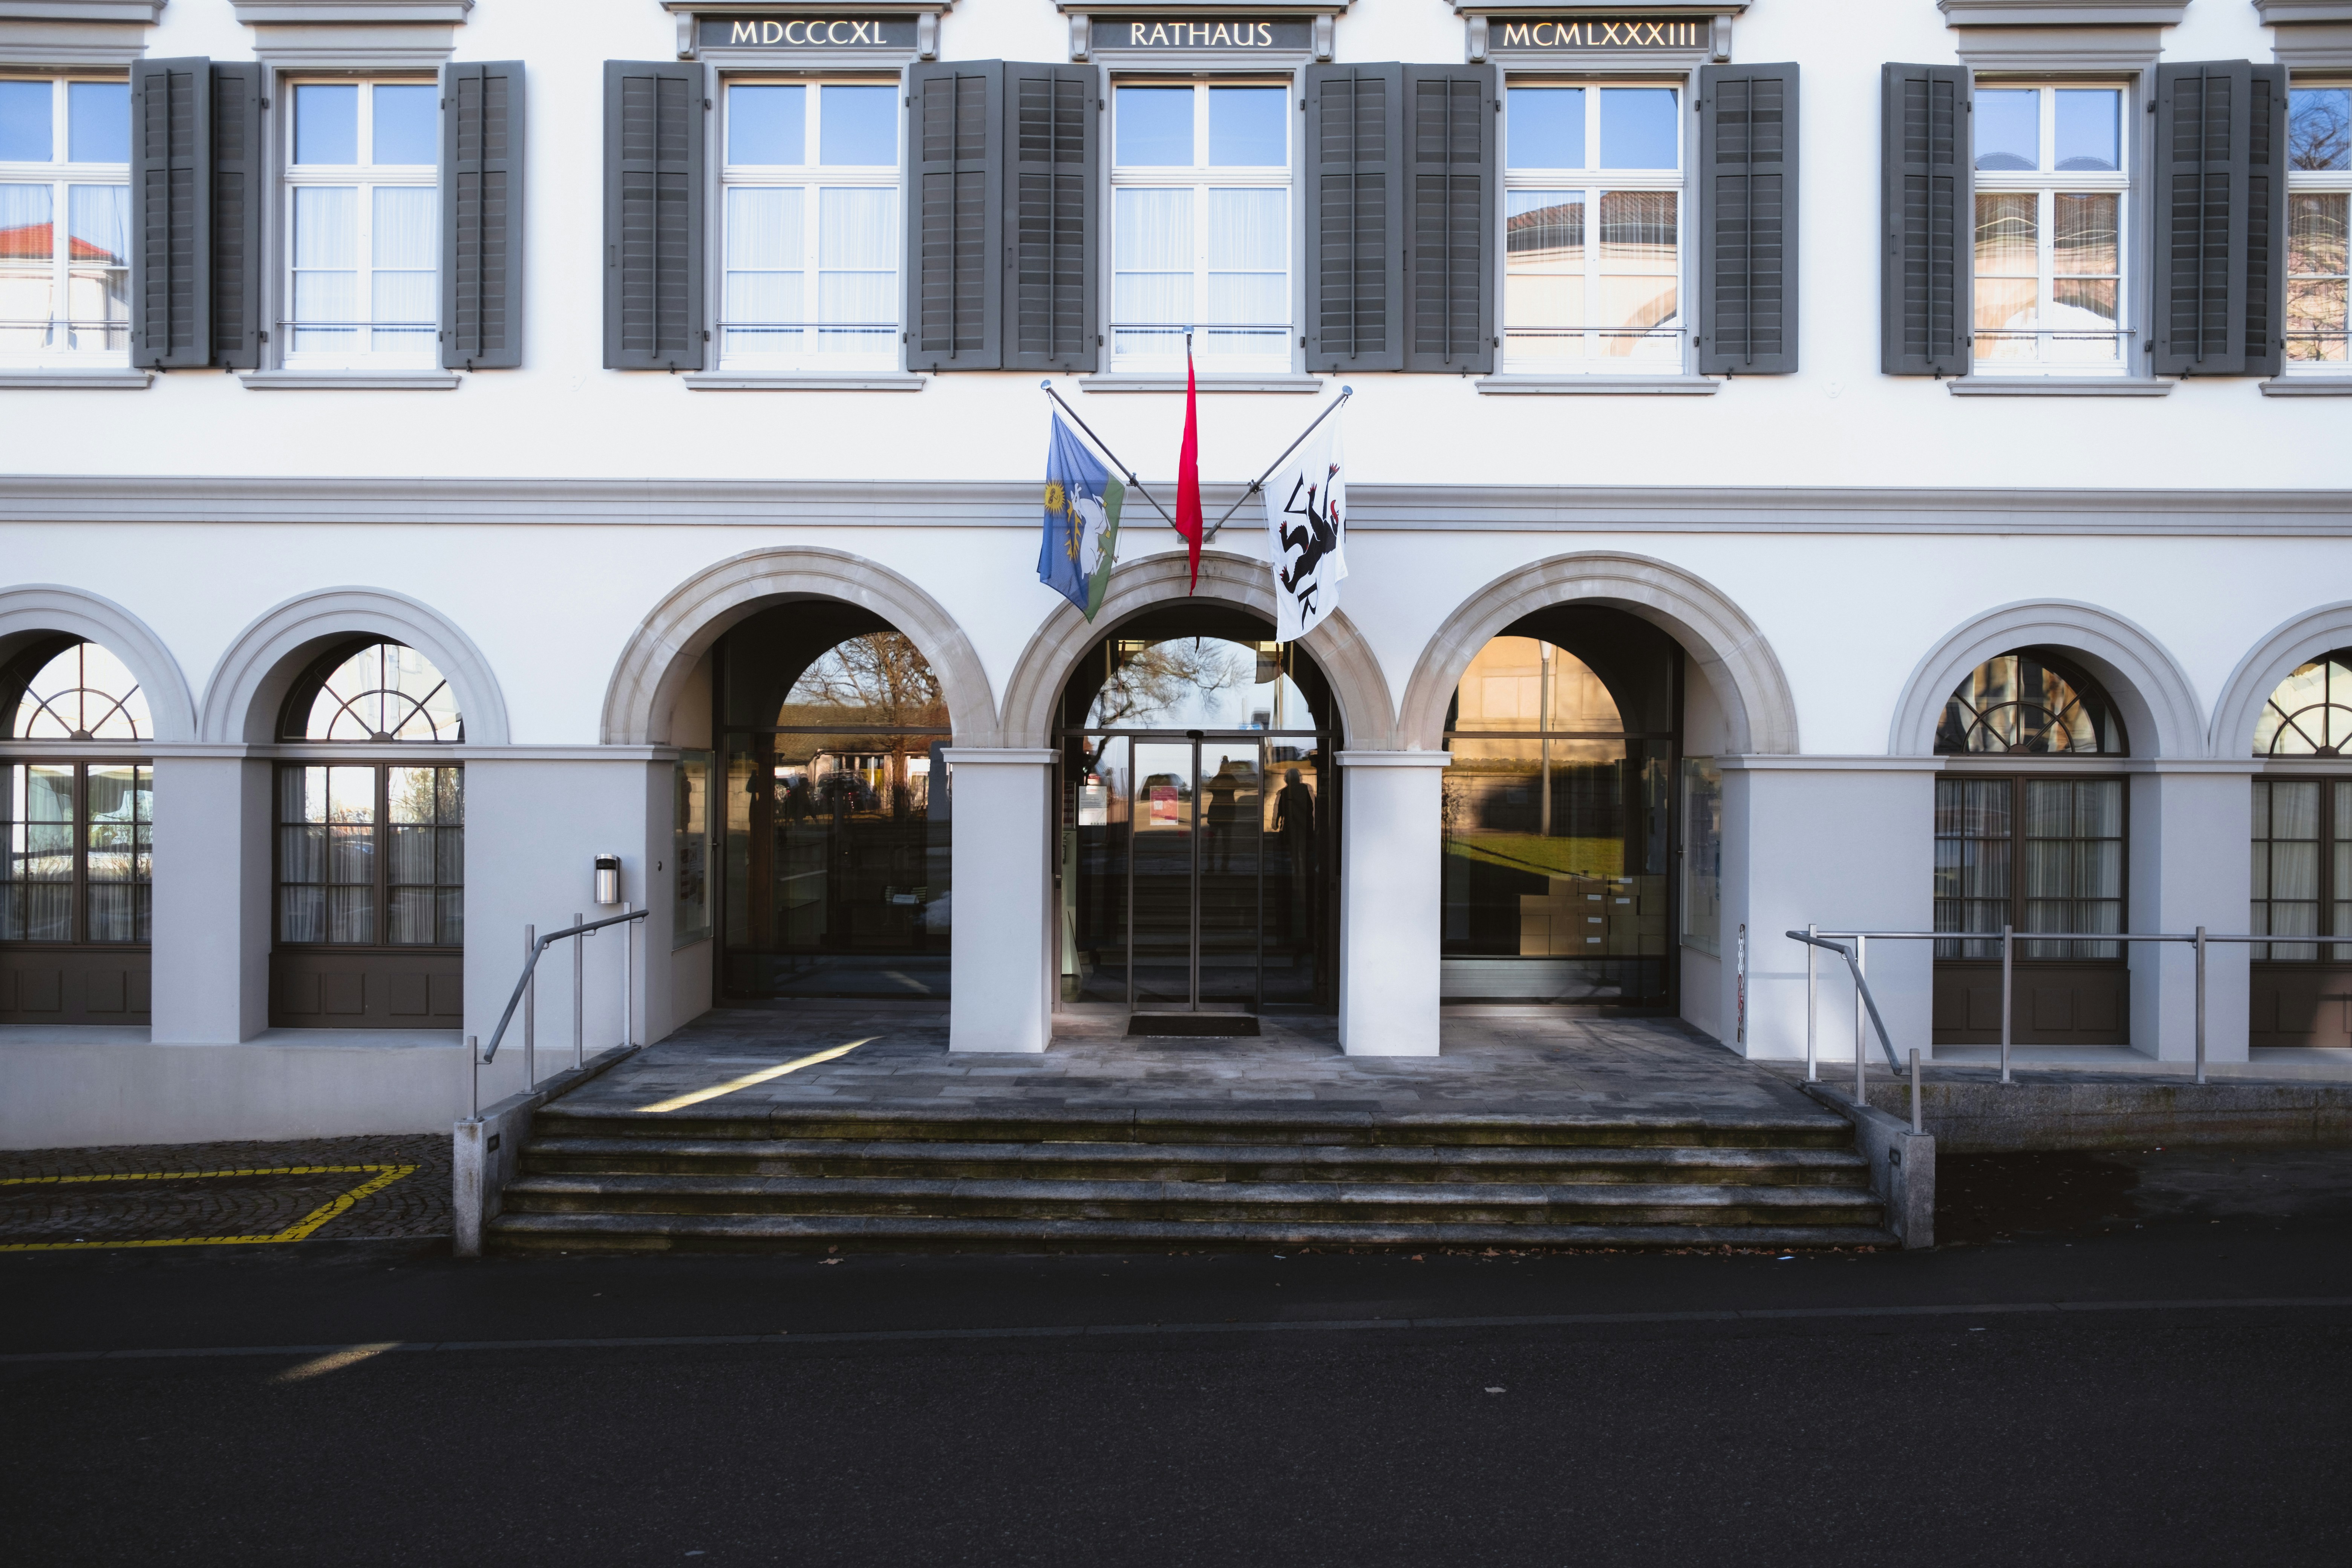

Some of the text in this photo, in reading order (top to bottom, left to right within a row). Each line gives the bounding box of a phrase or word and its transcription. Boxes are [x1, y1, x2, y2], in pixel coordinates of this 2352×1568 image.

[730, 21, 887, 44] MDCCCXL
[1130, 23, 1272, 46] RATHAUS
[1503, 23, 1695, 46] MCMLXXXIII
[1297, 577, 1318, 631] R
